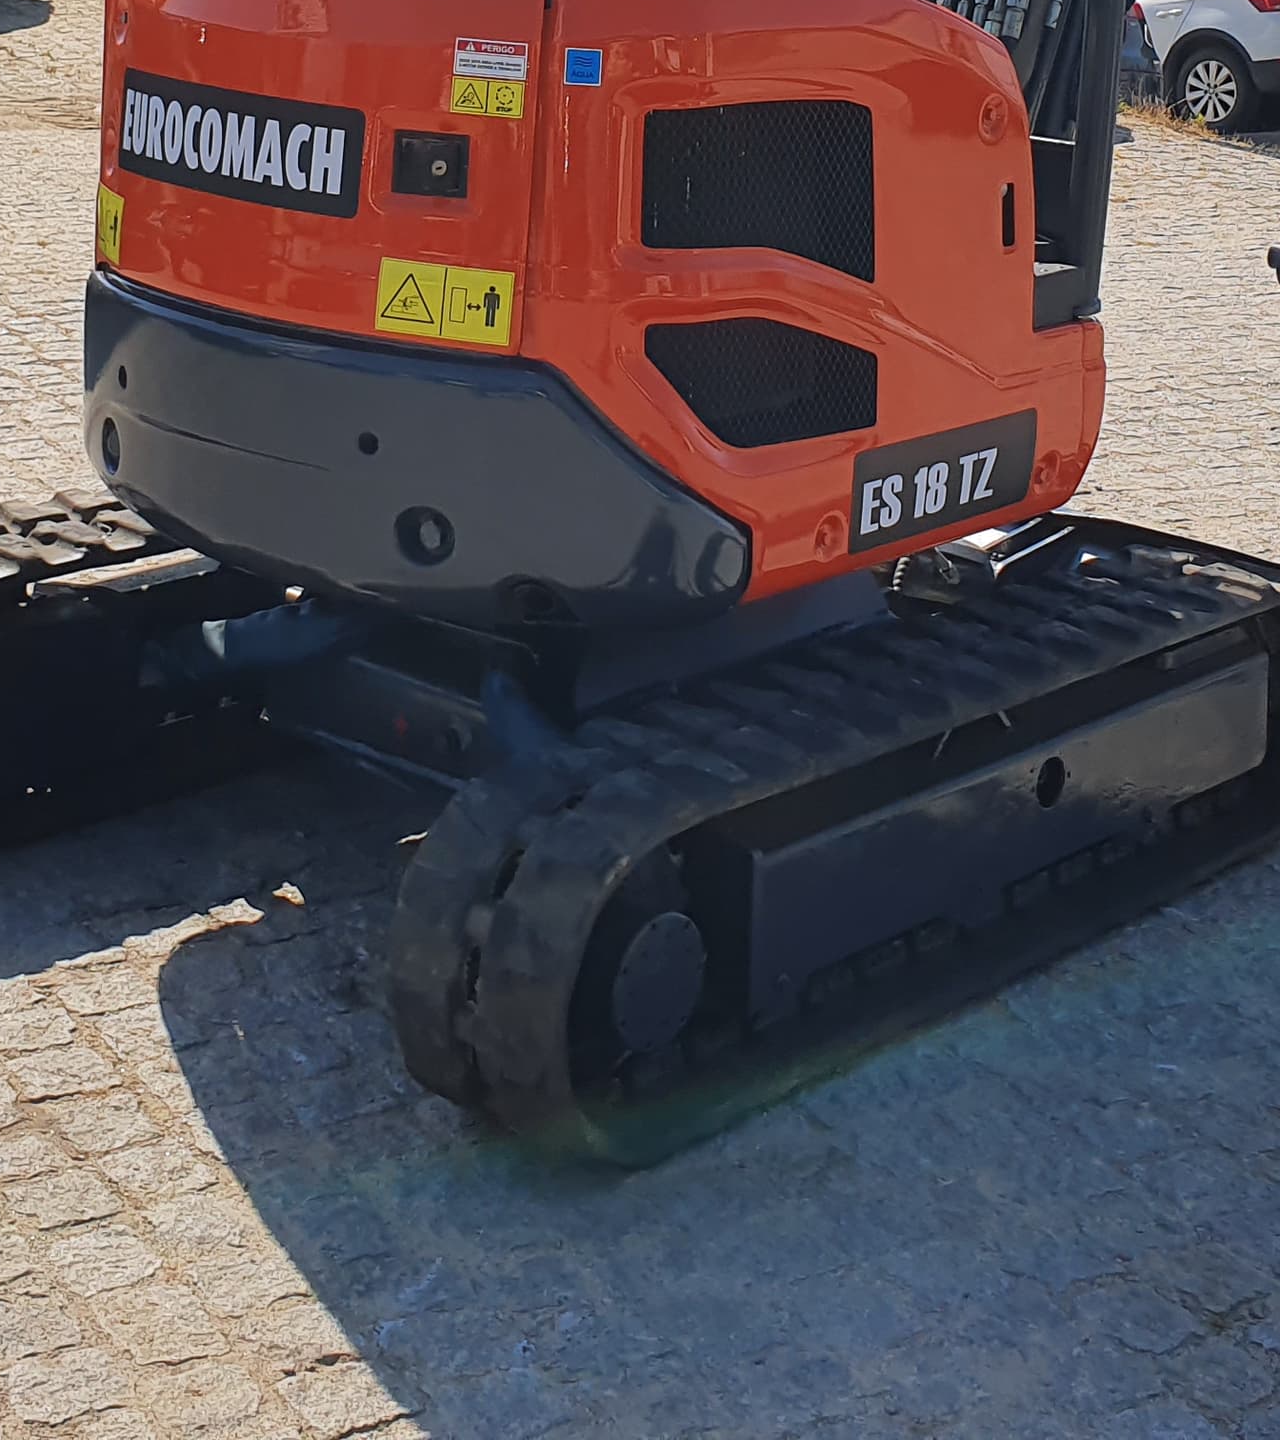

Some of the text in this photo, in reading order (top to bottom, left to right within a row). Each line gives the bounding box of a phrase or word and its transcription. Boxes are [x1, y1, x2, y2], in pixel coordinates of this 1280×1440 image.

[481, 43, 515, 55] PERIGO
[122, 88, 345, 195] EUROCOMACH
[860, 447, 998, 535] ES 18 TZ
